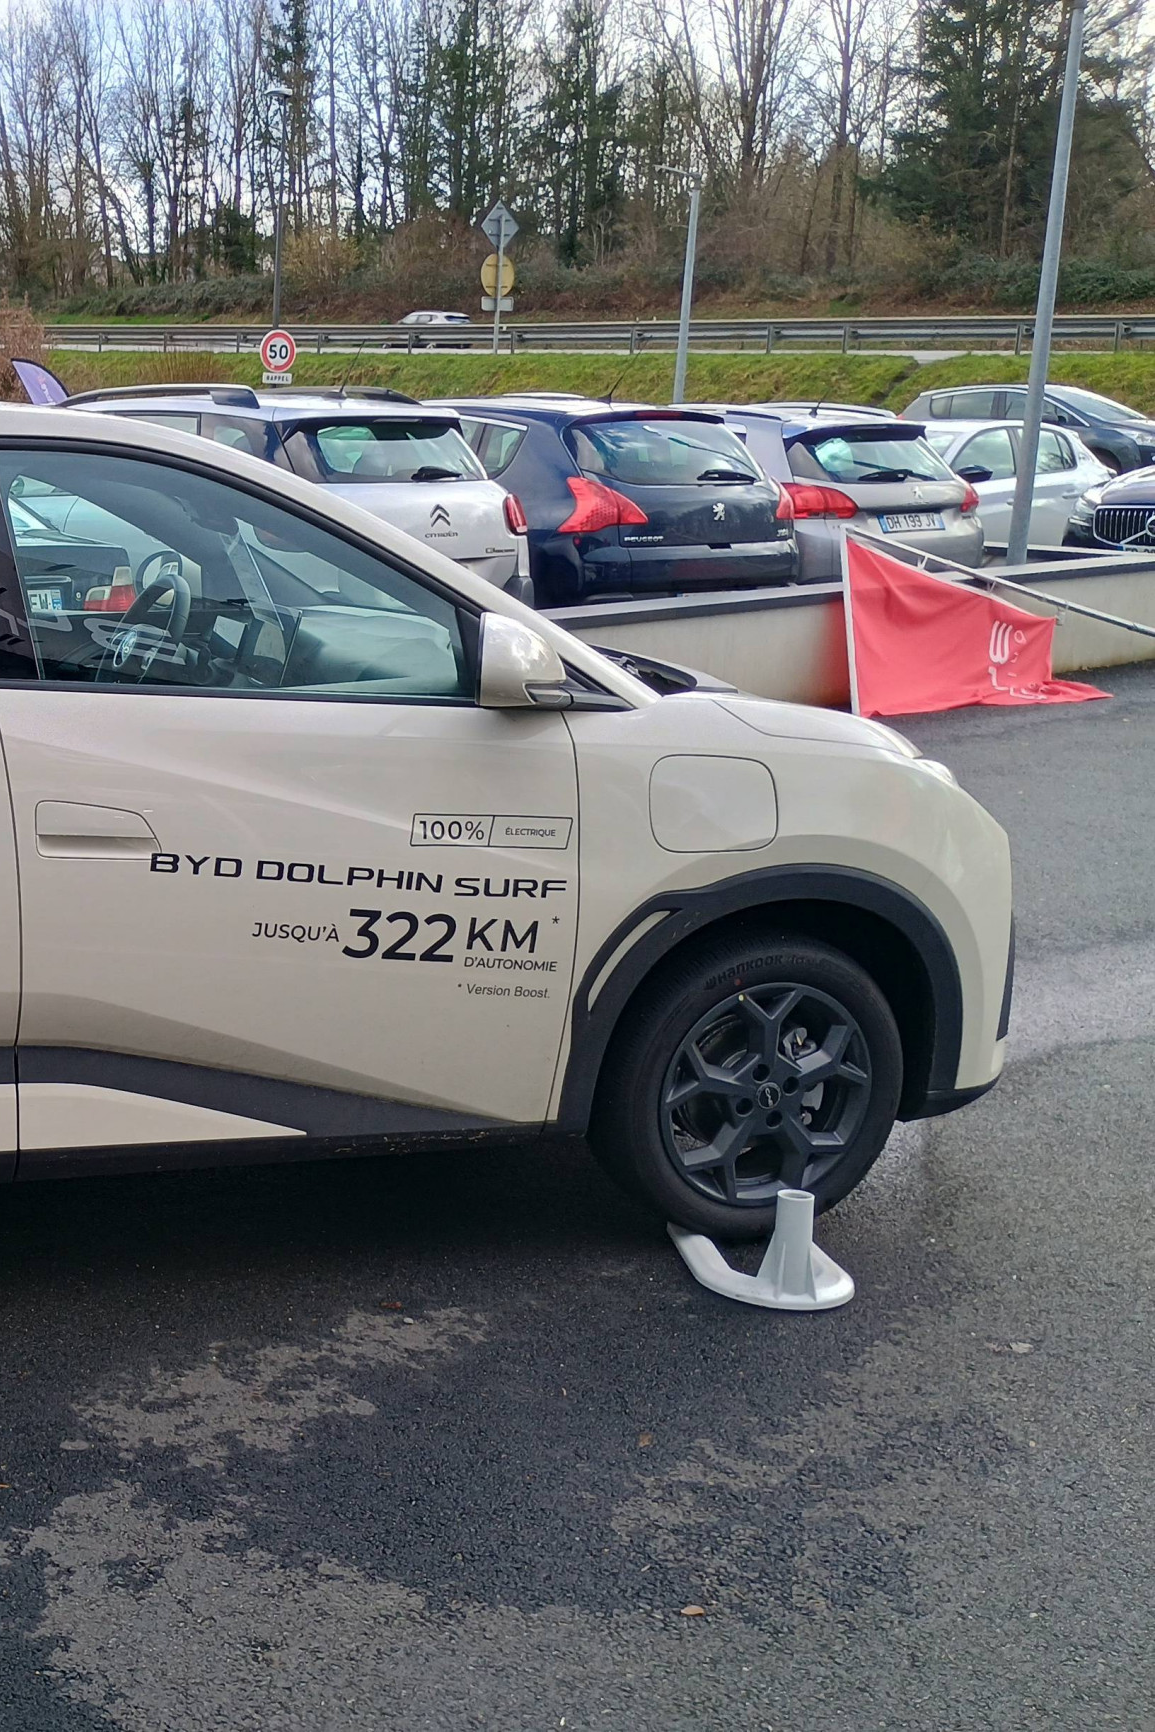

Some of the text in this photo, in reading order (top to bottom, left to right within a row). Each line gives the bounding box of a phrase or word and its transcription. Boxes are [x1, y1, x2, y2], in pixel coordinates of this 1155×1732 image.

[268, 344, 289, 360] 50
[419, 820, 556, 841] 100% ÉLECTRIQUE
[149, 852, 568, 899] BYD DOLPHIN SURF
[251, 908, 539, 963] JUSQU'À 322 KM
[463, 956, 558, 972] D'AUTONOMIE
[466, 983, 551, 999] Version Boost.
